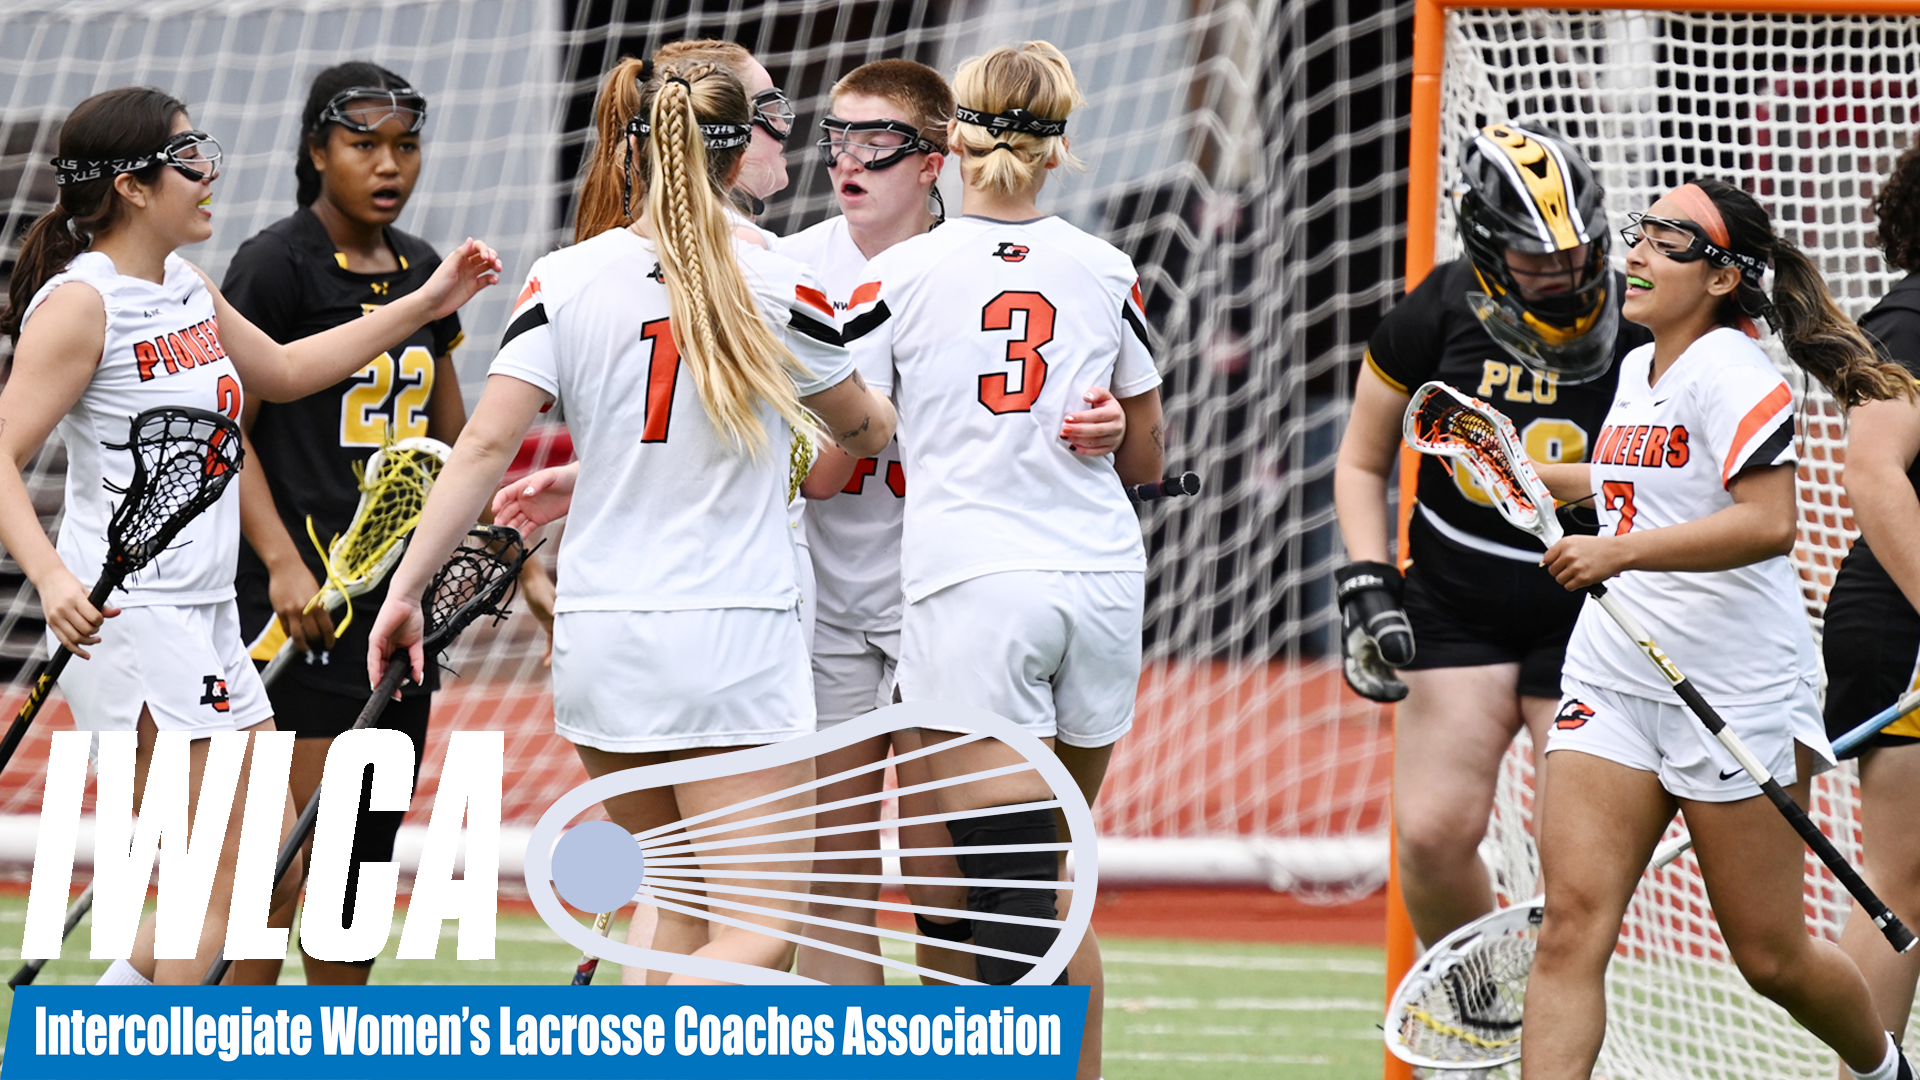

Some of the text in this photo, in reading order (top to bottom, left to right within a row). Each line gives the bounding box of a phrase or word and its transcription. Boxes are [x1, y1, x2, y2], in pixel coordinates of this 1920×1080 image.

[957, 108, 980, 123] STX
[71, 168, 101, 183] STX
[133, 316, 229, 383] PIONEE
[639, 316, 682, 444] 1
[978, 290, 1057, 416] 3
[339, 346, 435, 448] 22
[1477, 359, 1560, 405] PLU
[1602, 480, 1638, 538] 7
